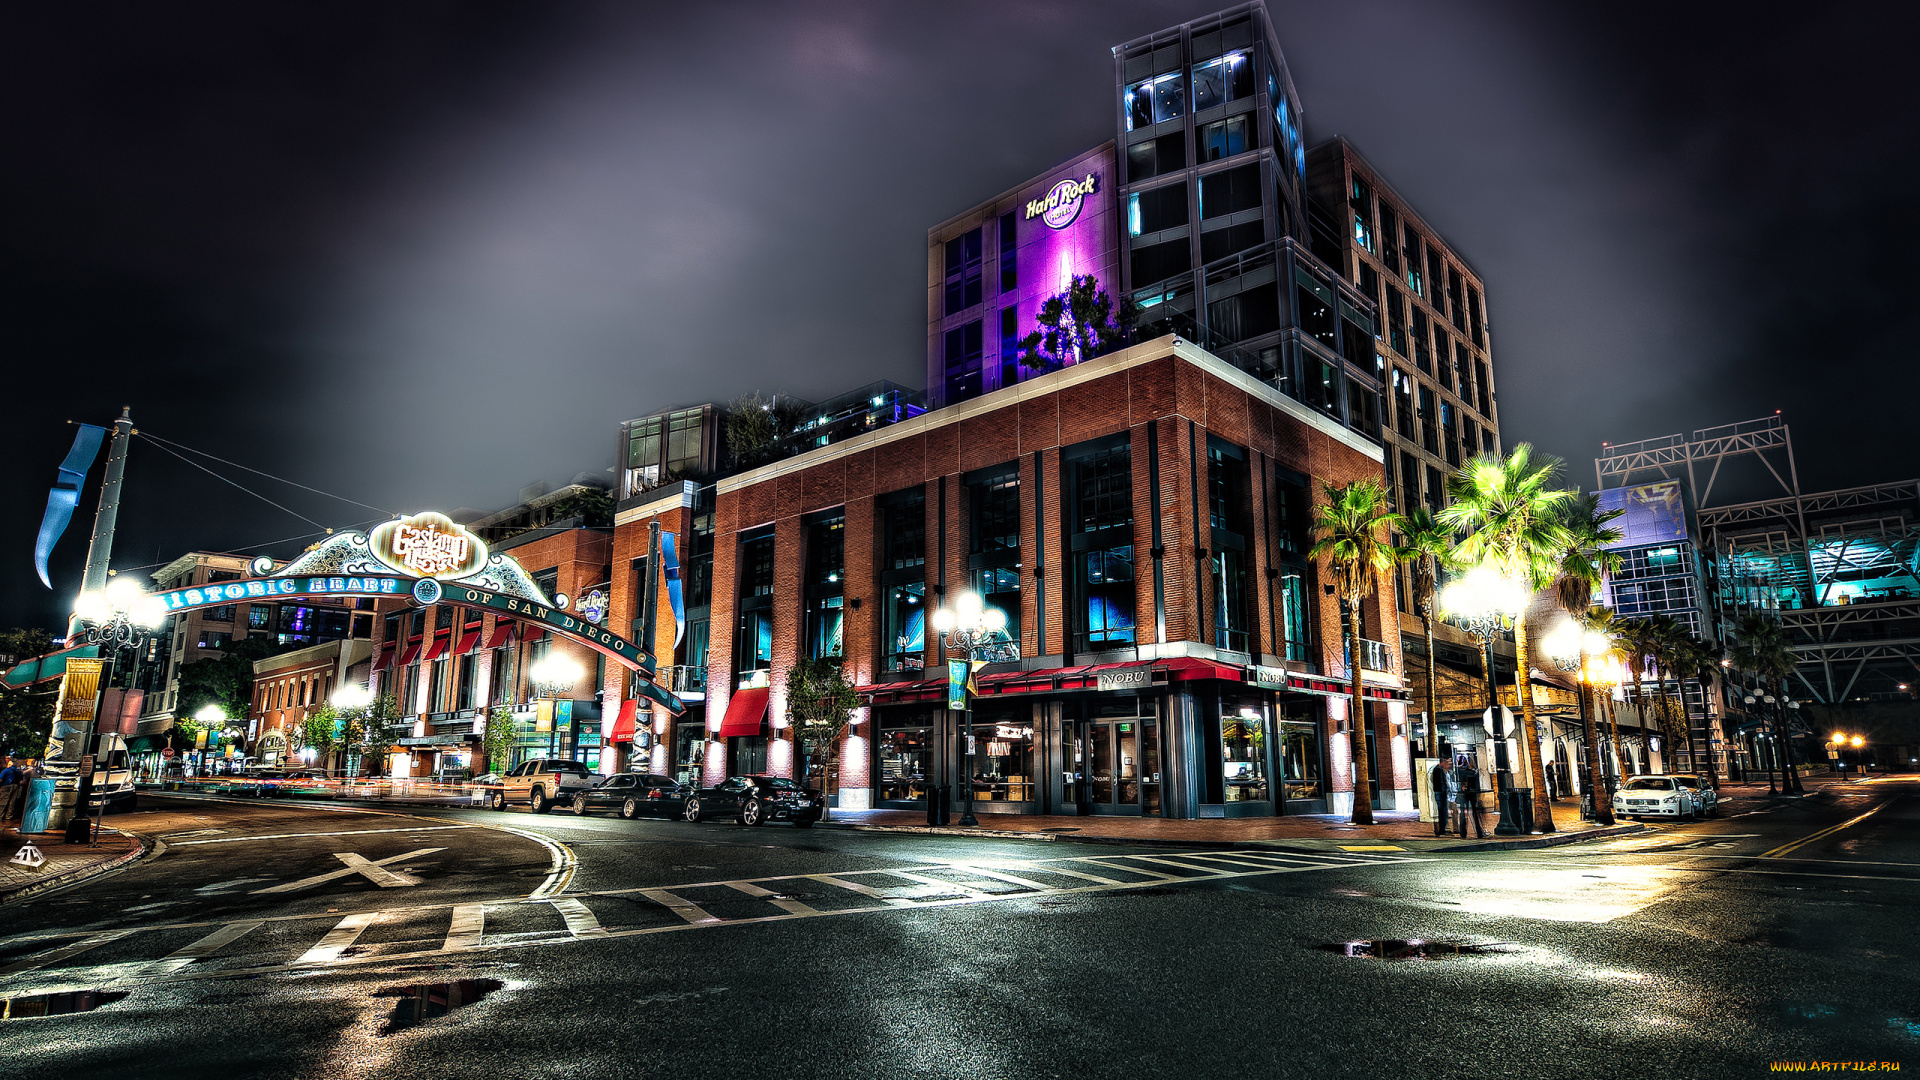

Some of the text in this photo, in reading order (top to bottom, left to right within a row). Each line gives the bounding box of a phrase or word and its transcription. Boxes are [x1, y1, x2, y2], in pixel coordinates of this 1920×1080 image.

[1025, 173, 1095, 219] Hard Rock
[392, 524, 469, 562] Gaslamp
[165, 578, 395, 609] ISTORIC HEART
[465, 590, 625, 651] OF SAN DIEGO
[1102, 671, 1145, 684] NOBU
[1259, 671, 1286, 684] NOBU
